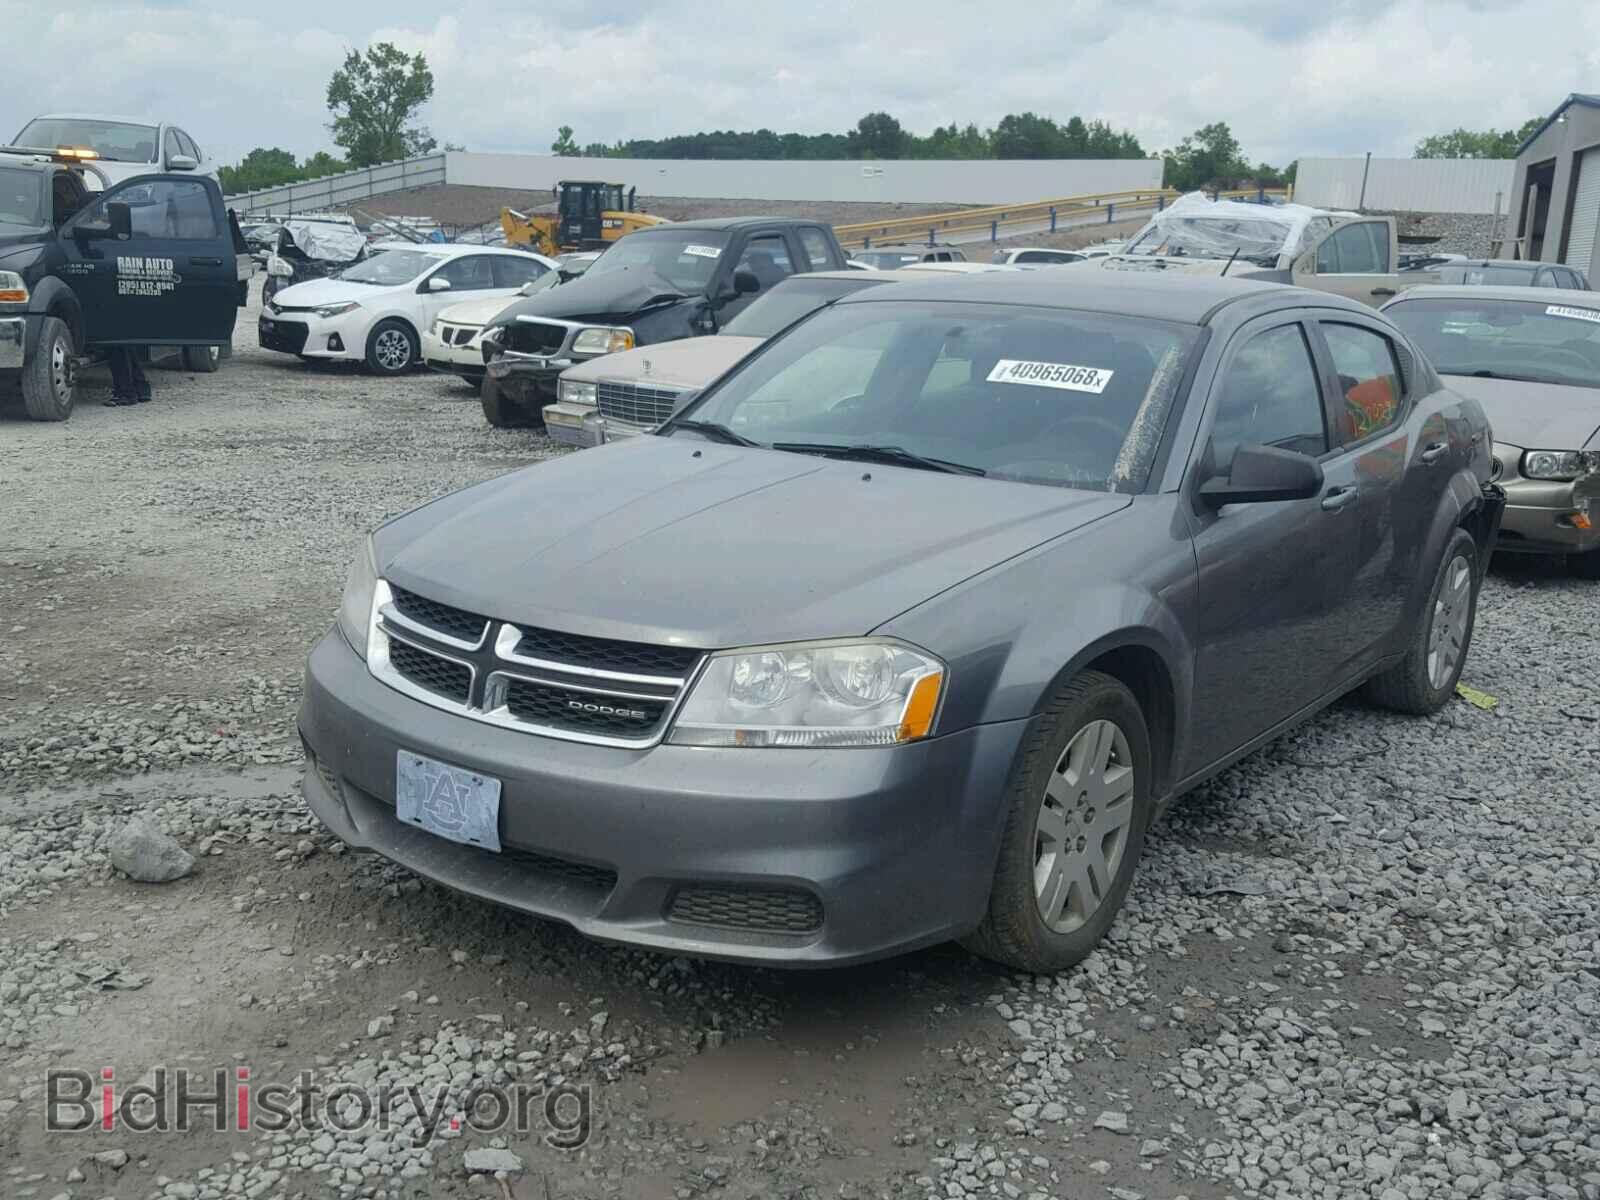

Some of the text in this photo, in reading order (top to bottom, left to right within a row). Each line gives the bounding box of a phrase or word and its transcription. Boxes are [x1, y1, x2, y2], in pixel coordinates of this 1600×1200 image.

[117, 256, 174, 270] RAIN AUTO
[568, 701, 645, 719] DODGE
